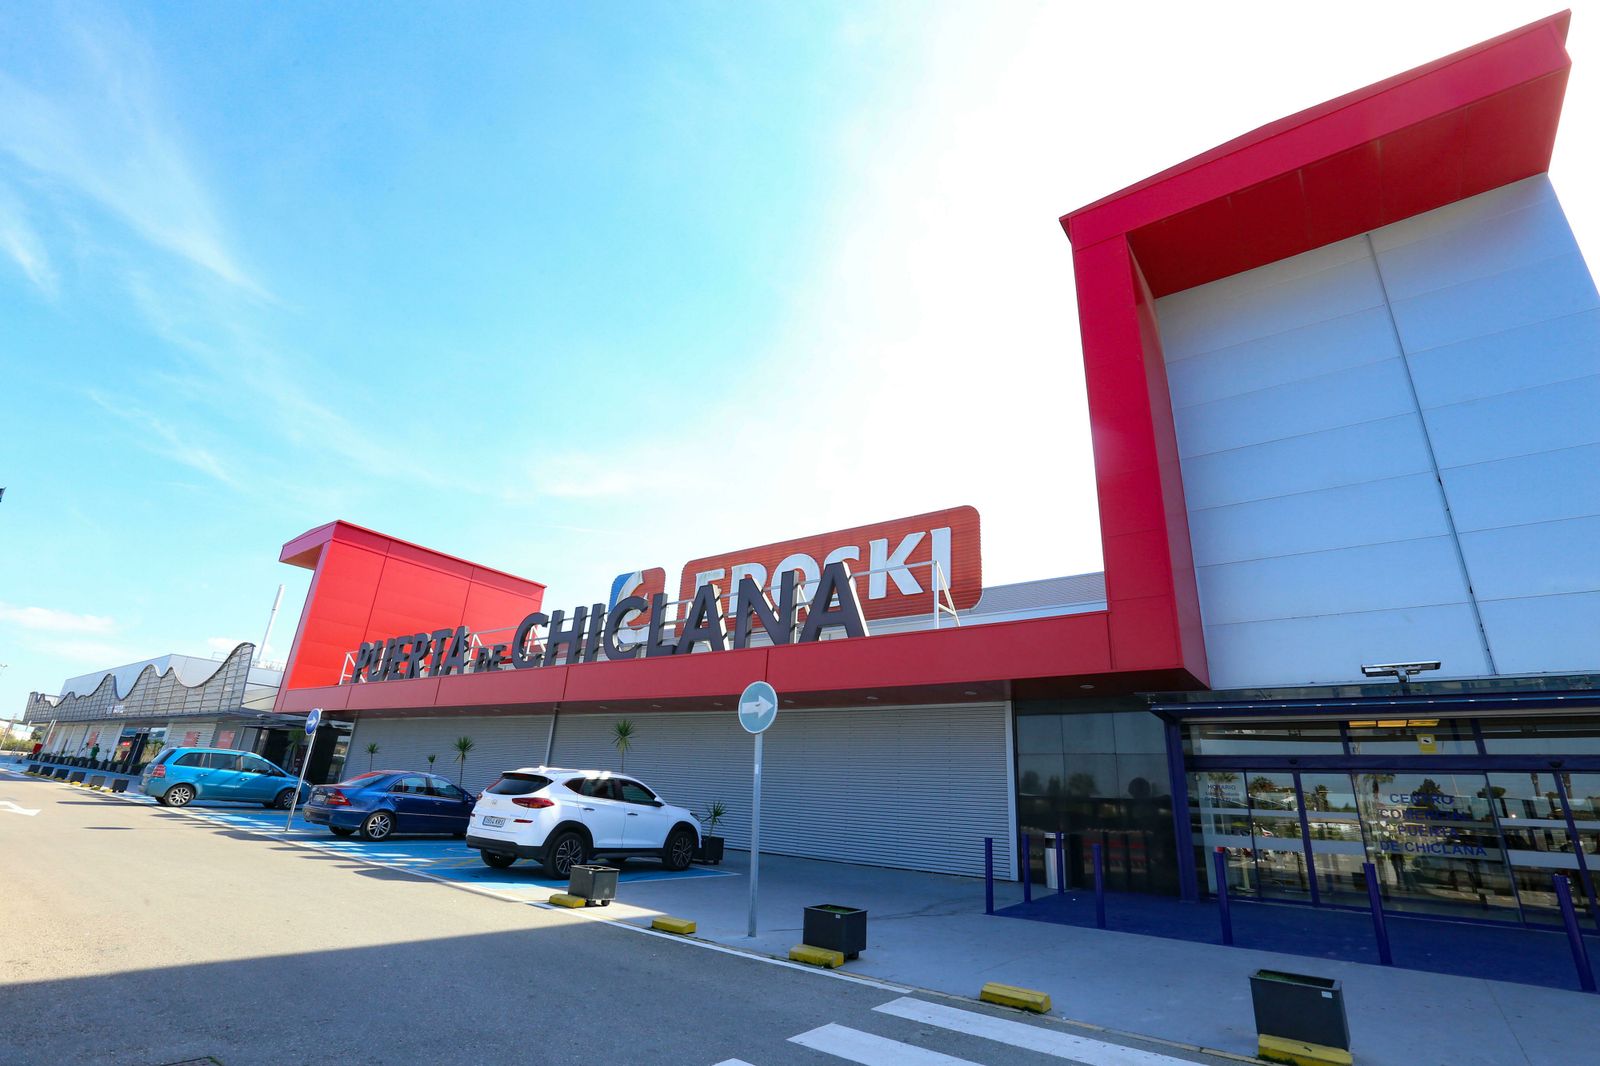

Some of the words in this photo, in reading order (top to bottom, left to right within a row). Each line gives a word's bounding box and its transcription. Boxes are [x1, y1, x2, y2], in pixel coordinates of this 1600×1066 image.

[351, 626, 469, 684] PUERTA
[474, 645, 508, 673] DE
[512, 561, 869, 670] CHICLANA
[1389, 793, 1455, 805] CENTRO
[1397, 824, 1459, 838] PUERTA
[1379, 840, 1401, 852] DE
[1404, 841, 1488, 857] CHICLANA
